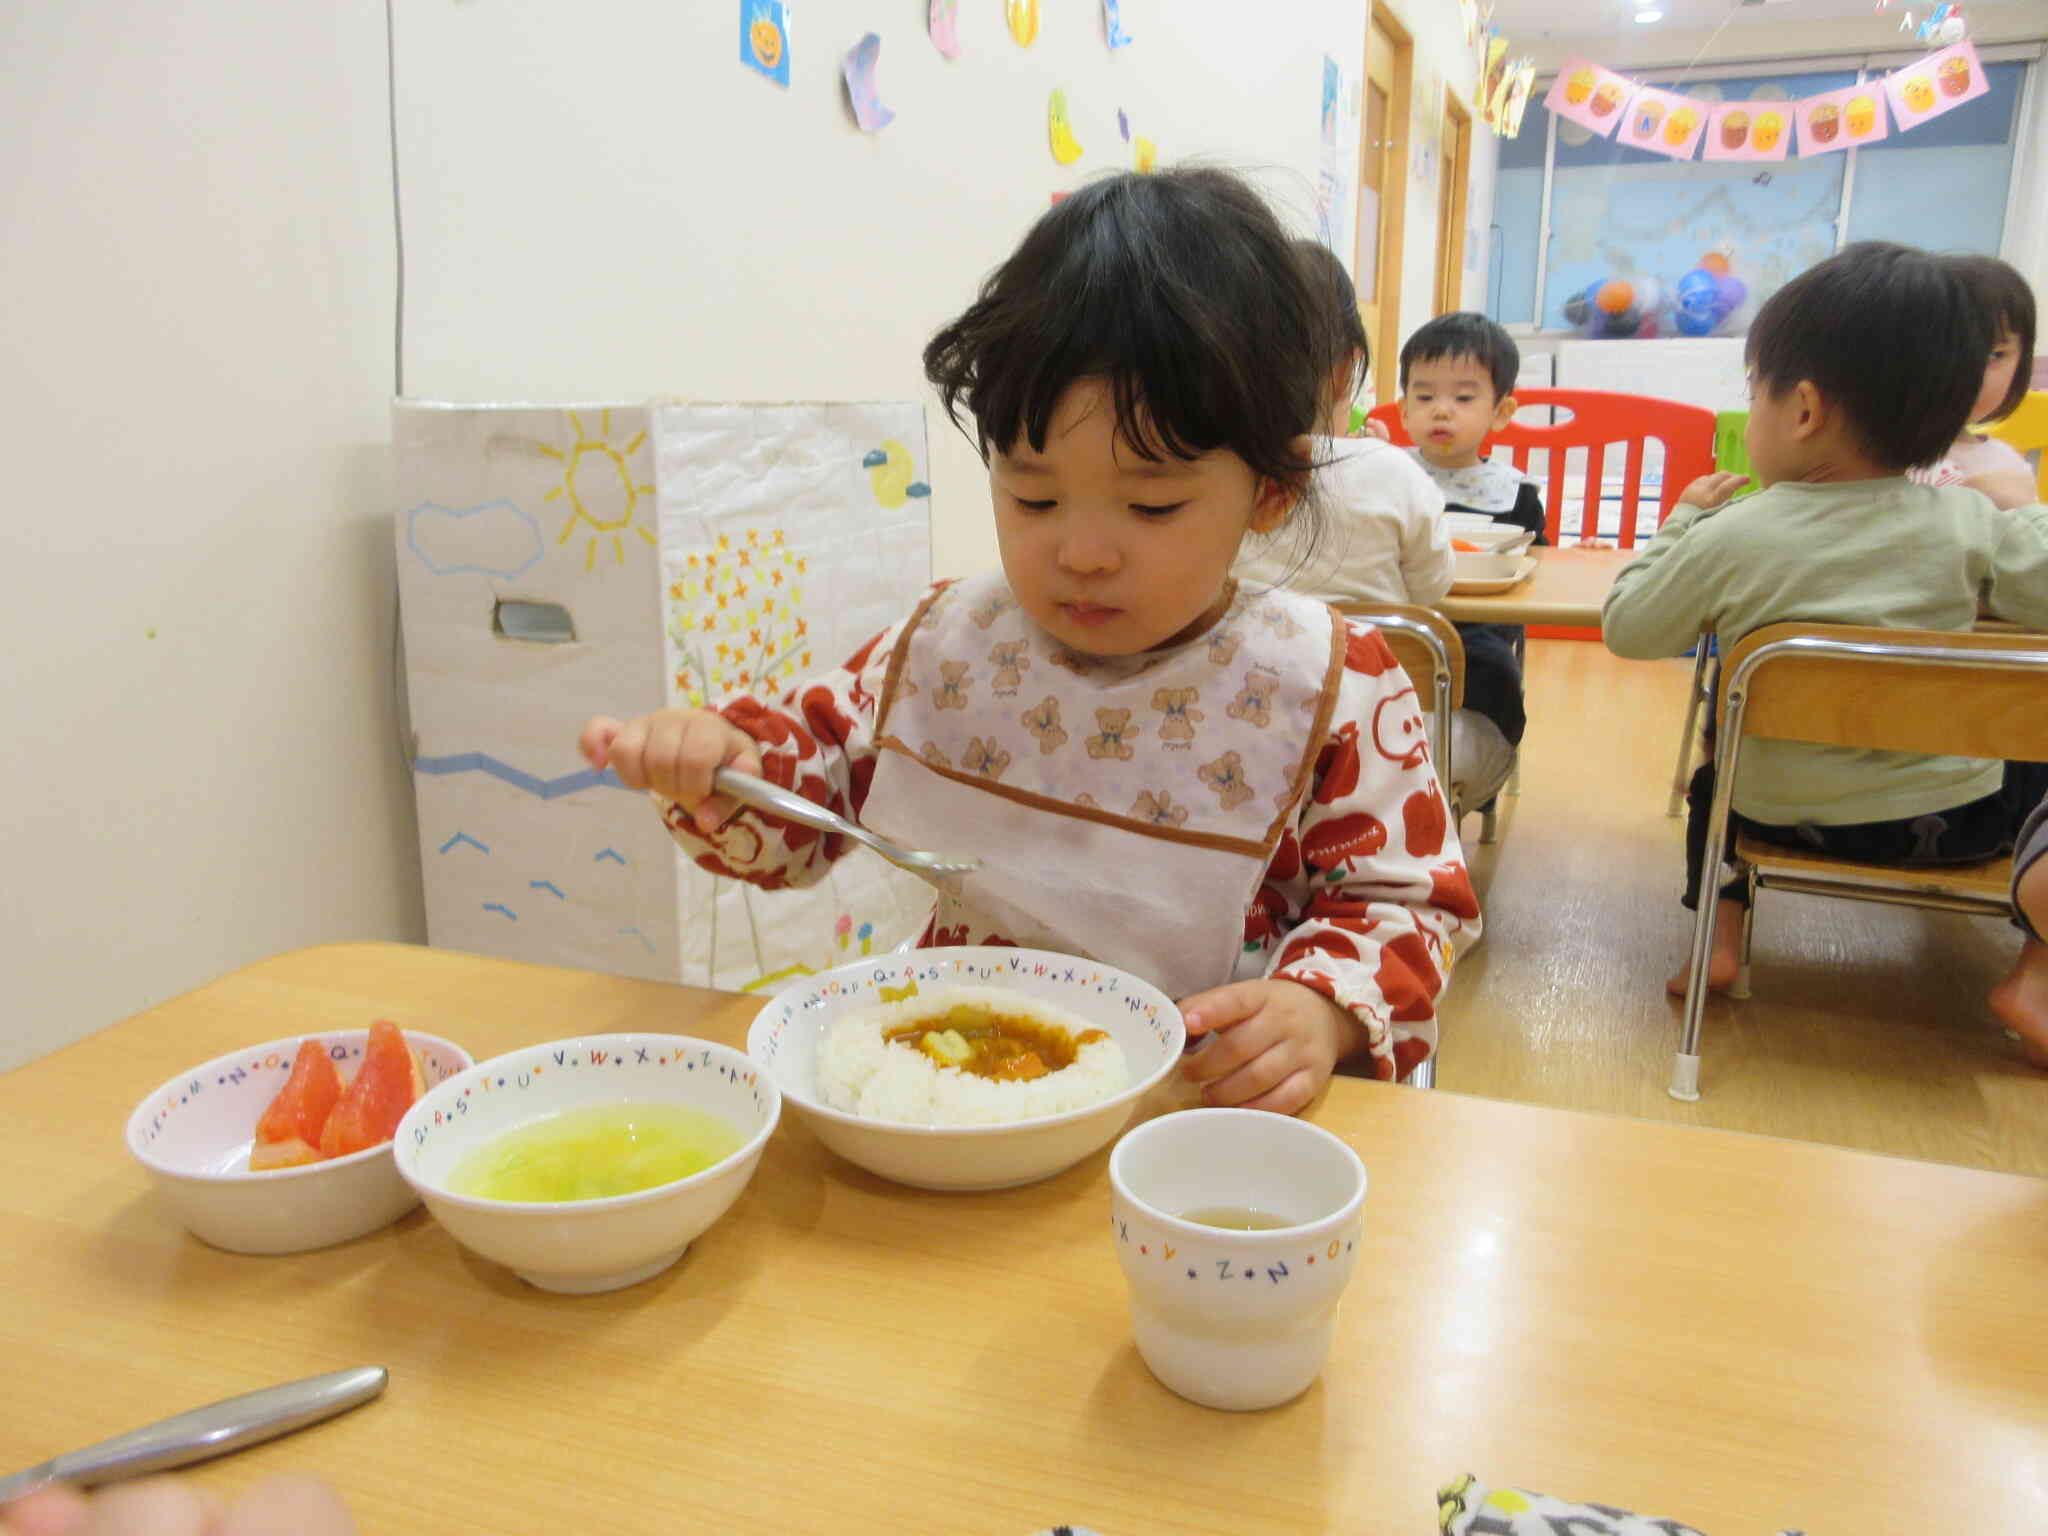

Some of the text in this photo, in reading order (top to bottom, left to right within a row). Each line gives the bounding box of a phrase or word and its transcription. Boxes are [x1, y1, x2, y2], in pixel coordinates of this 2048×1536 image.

[832, 981, 840, 996] O
[874, 968, 888, 982] Q
[929, 967, 938, 979] S
[980, 967, 991, 979] U
[1010, 956, 1020, 970] V
[1034, 961, 1047, 976] W
[1064, 967, 1075, 982] X
[1109, 978, 1119, 992] Z
[1130, 998, 1141, 1012] N
[265, 1053, 279, 1070] O
[330, 1045, 348, 1060] Q
[434, 1111, 443, 1125] R
[518, 1072, 530, 1089] U
[553, 1049, 565, 1066] V
[591, 1049, 608, 1066] W
[633, 1047, 649, 1065] X
[701, 1050, 712, 1067] Z
[1119, 1219, 1129, 1242] X
[1216, 1259, 1234, 1280] Z
[1327, 1239, 1341, 1261] O
